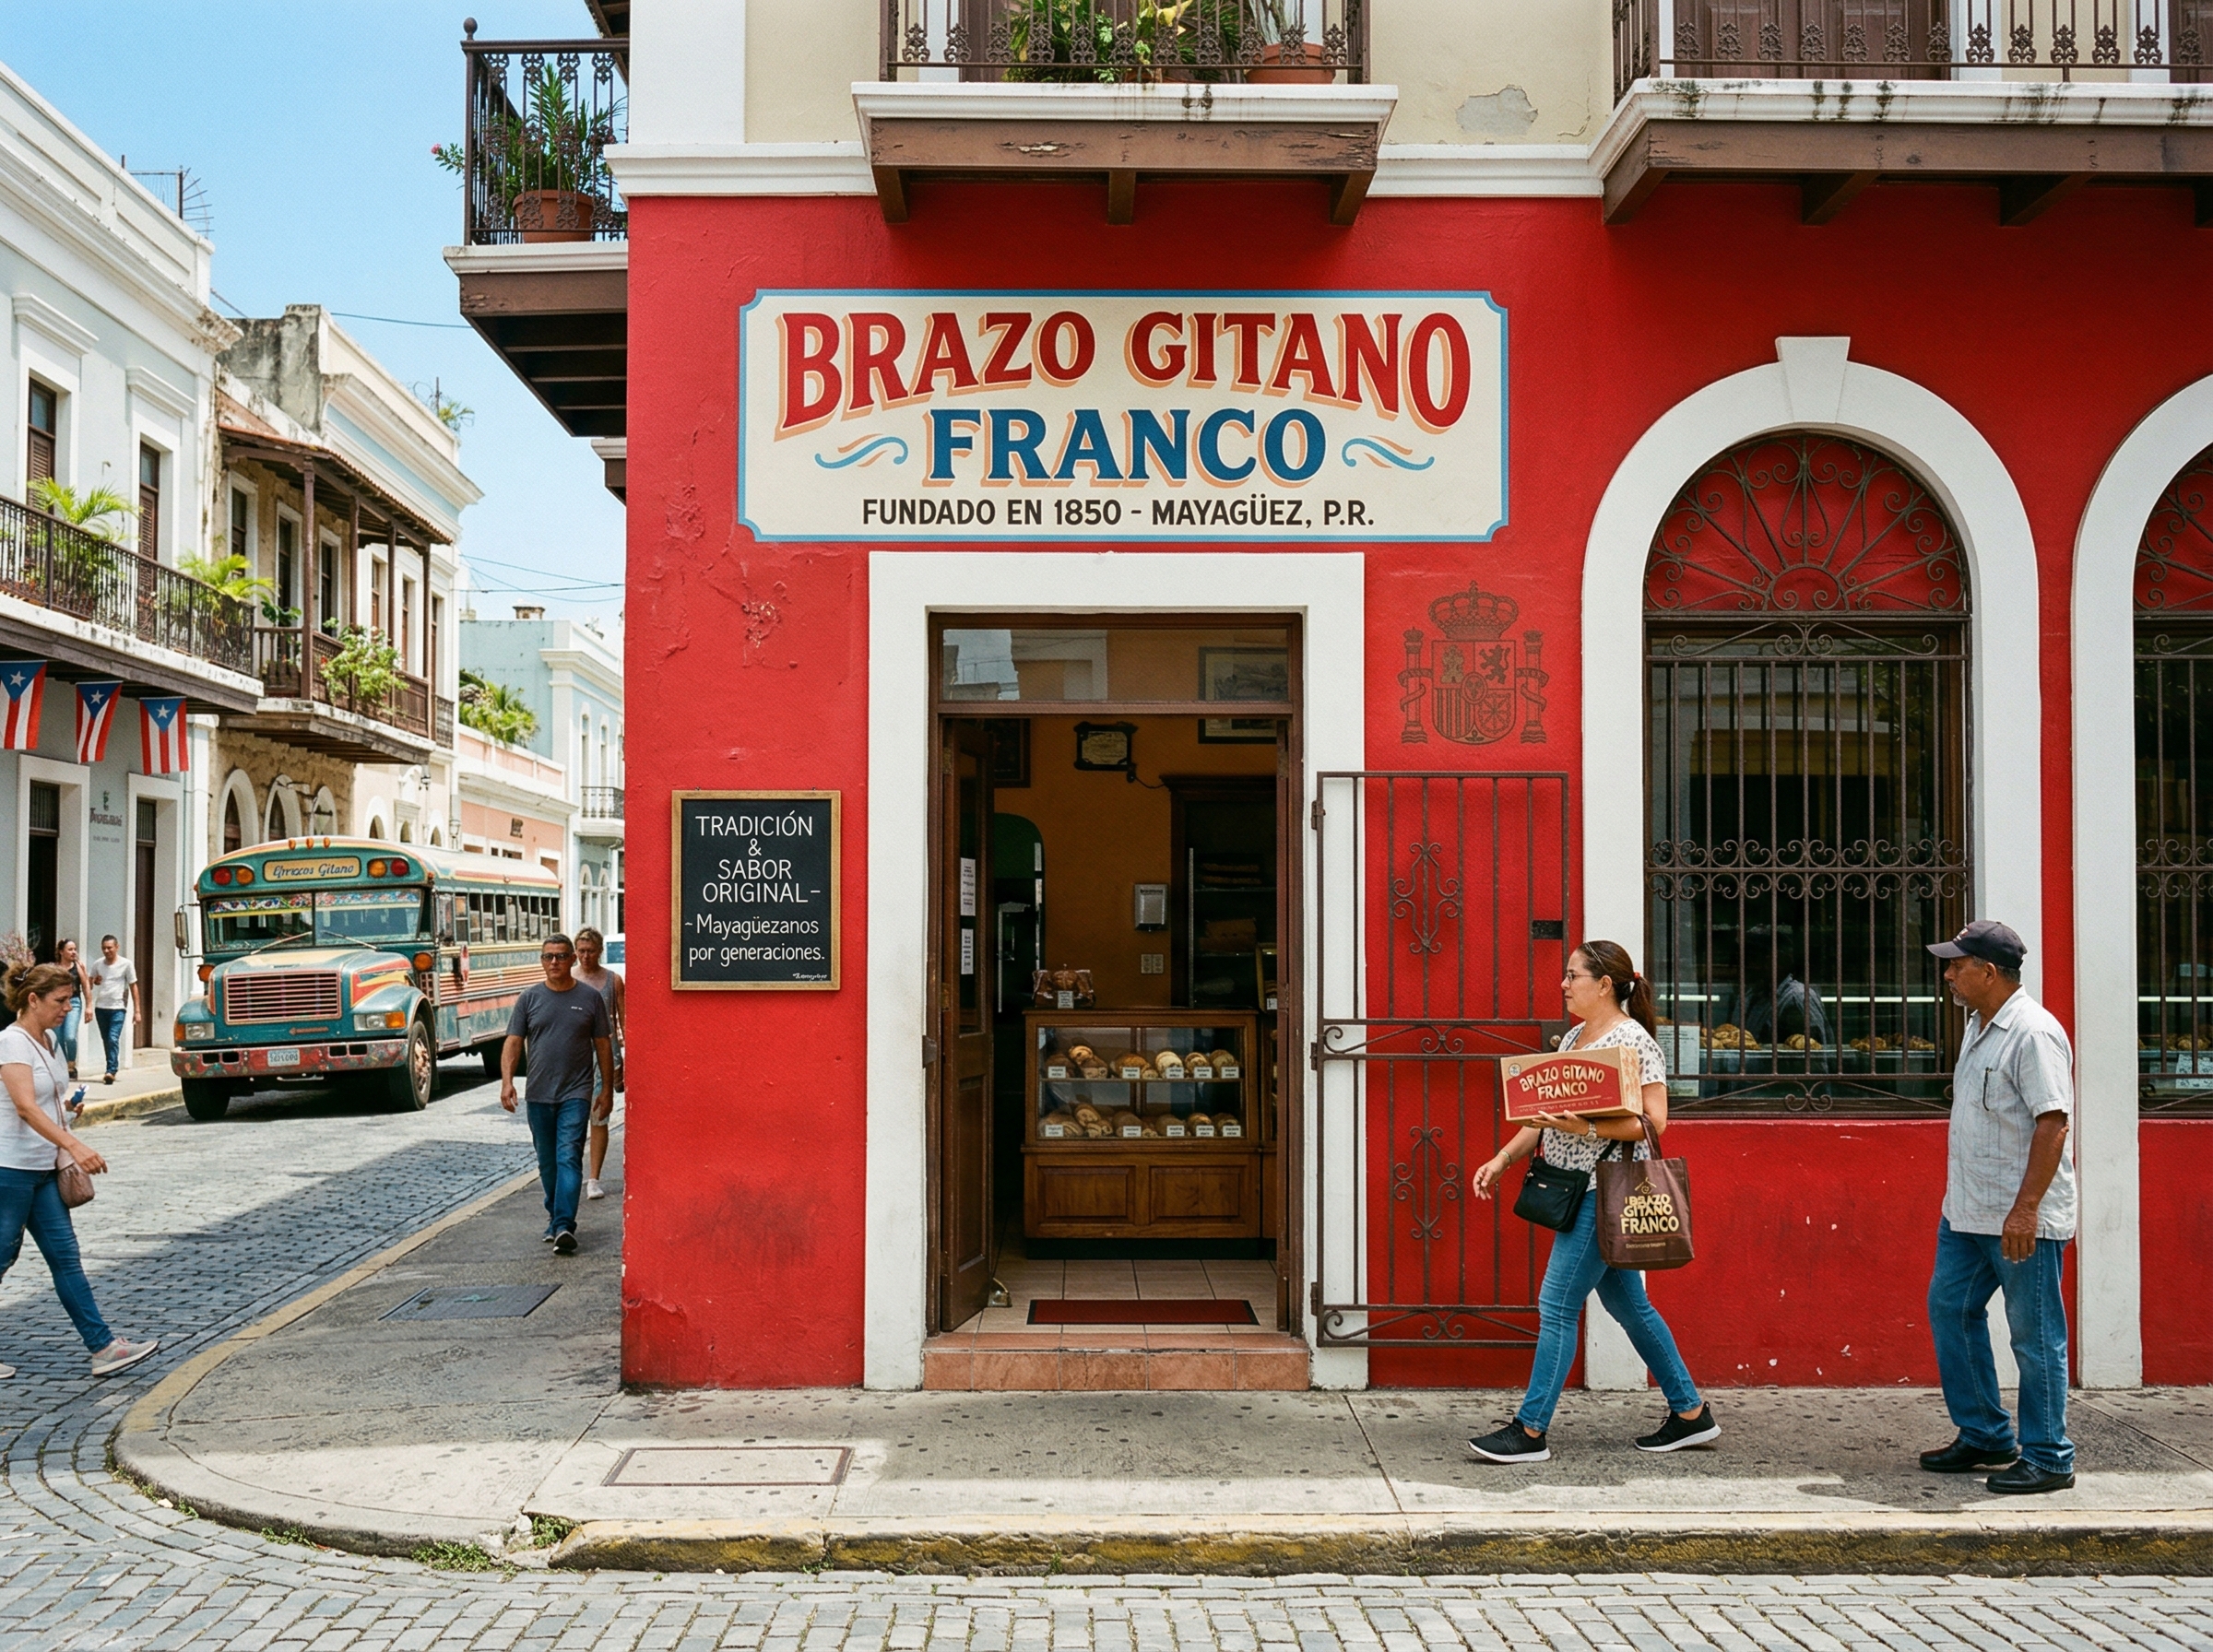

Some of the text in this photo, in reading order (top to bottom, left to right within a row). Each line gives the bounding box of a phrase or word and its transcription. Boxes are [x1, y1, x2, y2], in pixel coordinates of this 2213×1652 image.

[775, 311, 1472, 442] BRAZO GITANO
[922, 408, 1326, 488] FRANCO
[863, 499, 996, 525] FUNDADO
[1007, 499, 1043, 525] EN
[1054, 499, 1122, 525] 1850
[1152, 493, 1312, 528] MAYAGÜEZ,
[1324, 499, 1375, 525] P.R.
[695, 810, 812, 836] TRADICIÓN
[748, 838, 762, 856] &
[318, 864, 354, 877] Gitano
[717, 859, 792, 879] SABOR
[689, 943, 825, 967] por generaciones.
[1562, 1065, 1605, 1084] GITANO
[1537, 1081, 1588, 1101] FRANCO
[1623, 1204, 1674, 1217] GITANO
[1620, 1216, 1680, 1234] FRANCO
